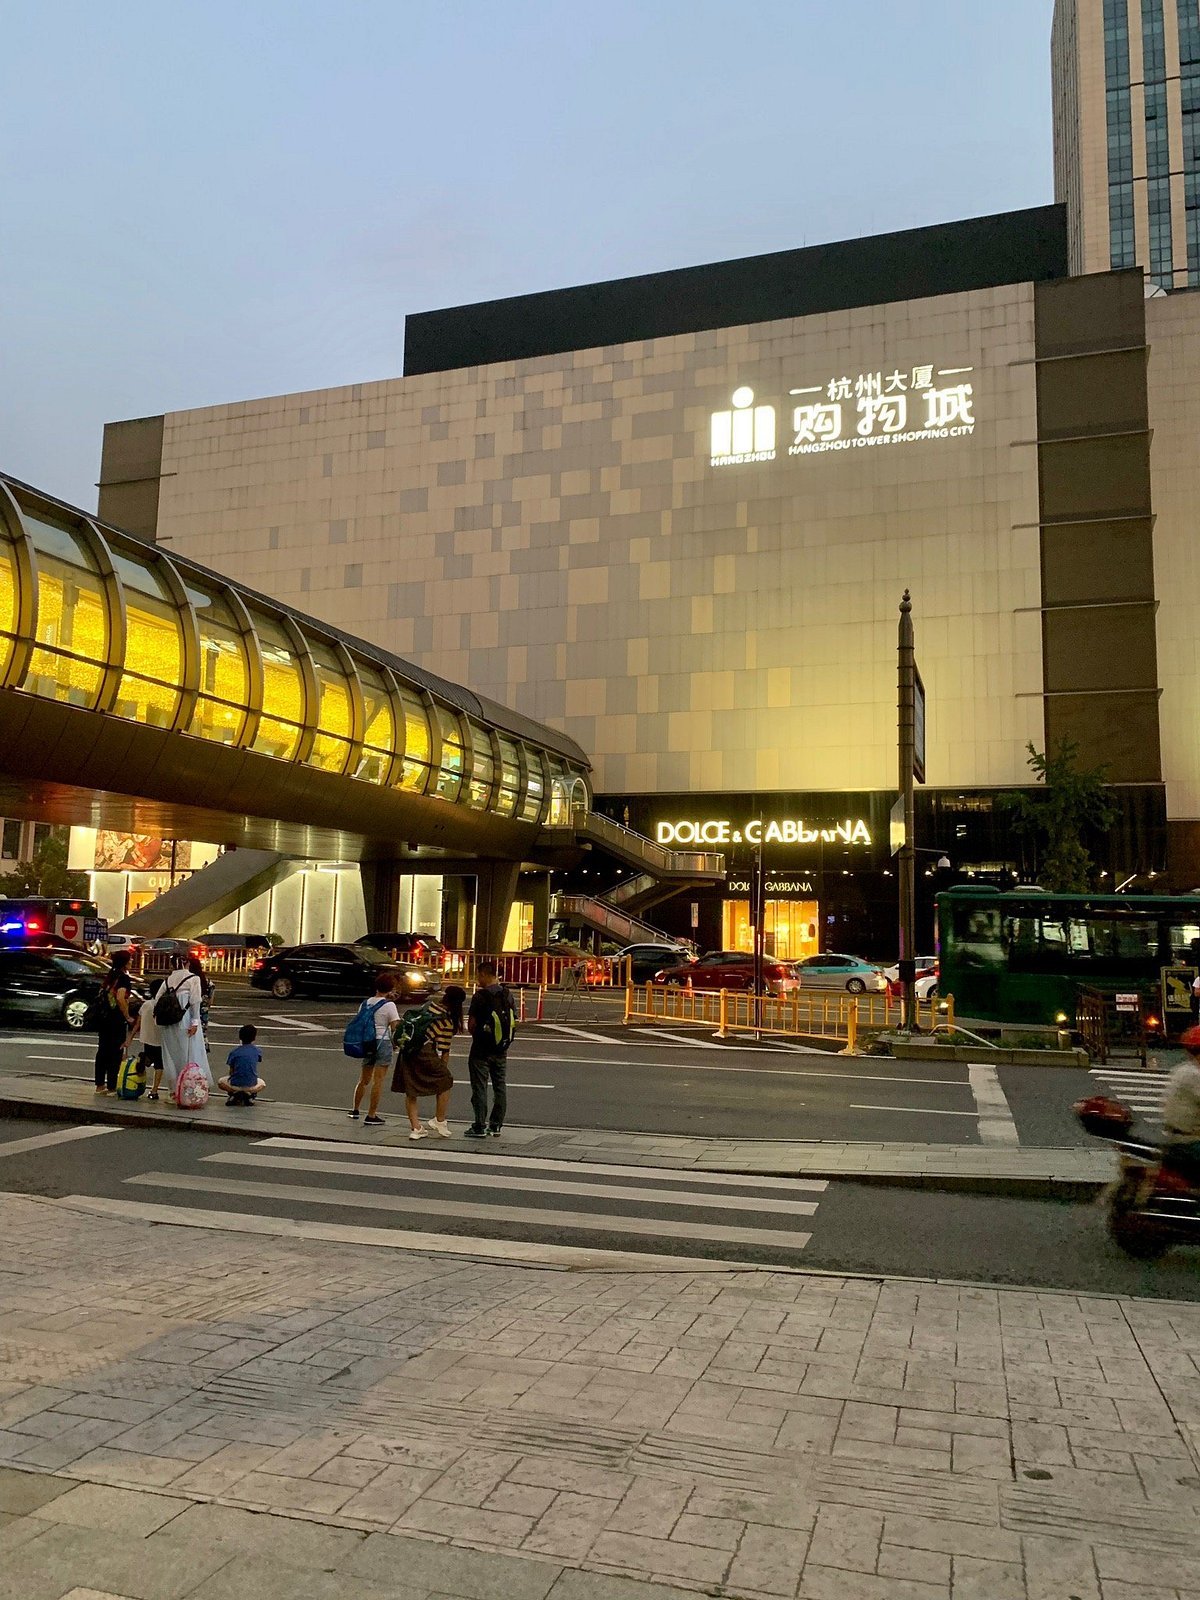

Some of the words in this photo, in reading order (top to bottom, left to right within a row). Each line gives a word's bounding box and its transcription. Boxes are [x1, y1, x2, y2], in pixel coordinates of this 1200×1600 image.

[827, 365, 935, 401] 杭州大厦
[793, 384, 976, 445] 购物城
[788, 438, 851, 456] HANGZHOU
[852, 432, 890, 448] TOWER
[891, 427, 949, 444] SHOPPING
[949, 425, 975, 438] CITY
[710, 449, 776, 467] HANGZHOU
[657, 821, 730, 843] DOLCE
[732, 831, 743, 843] &
[764, 881, 813, 892] GABBANA
